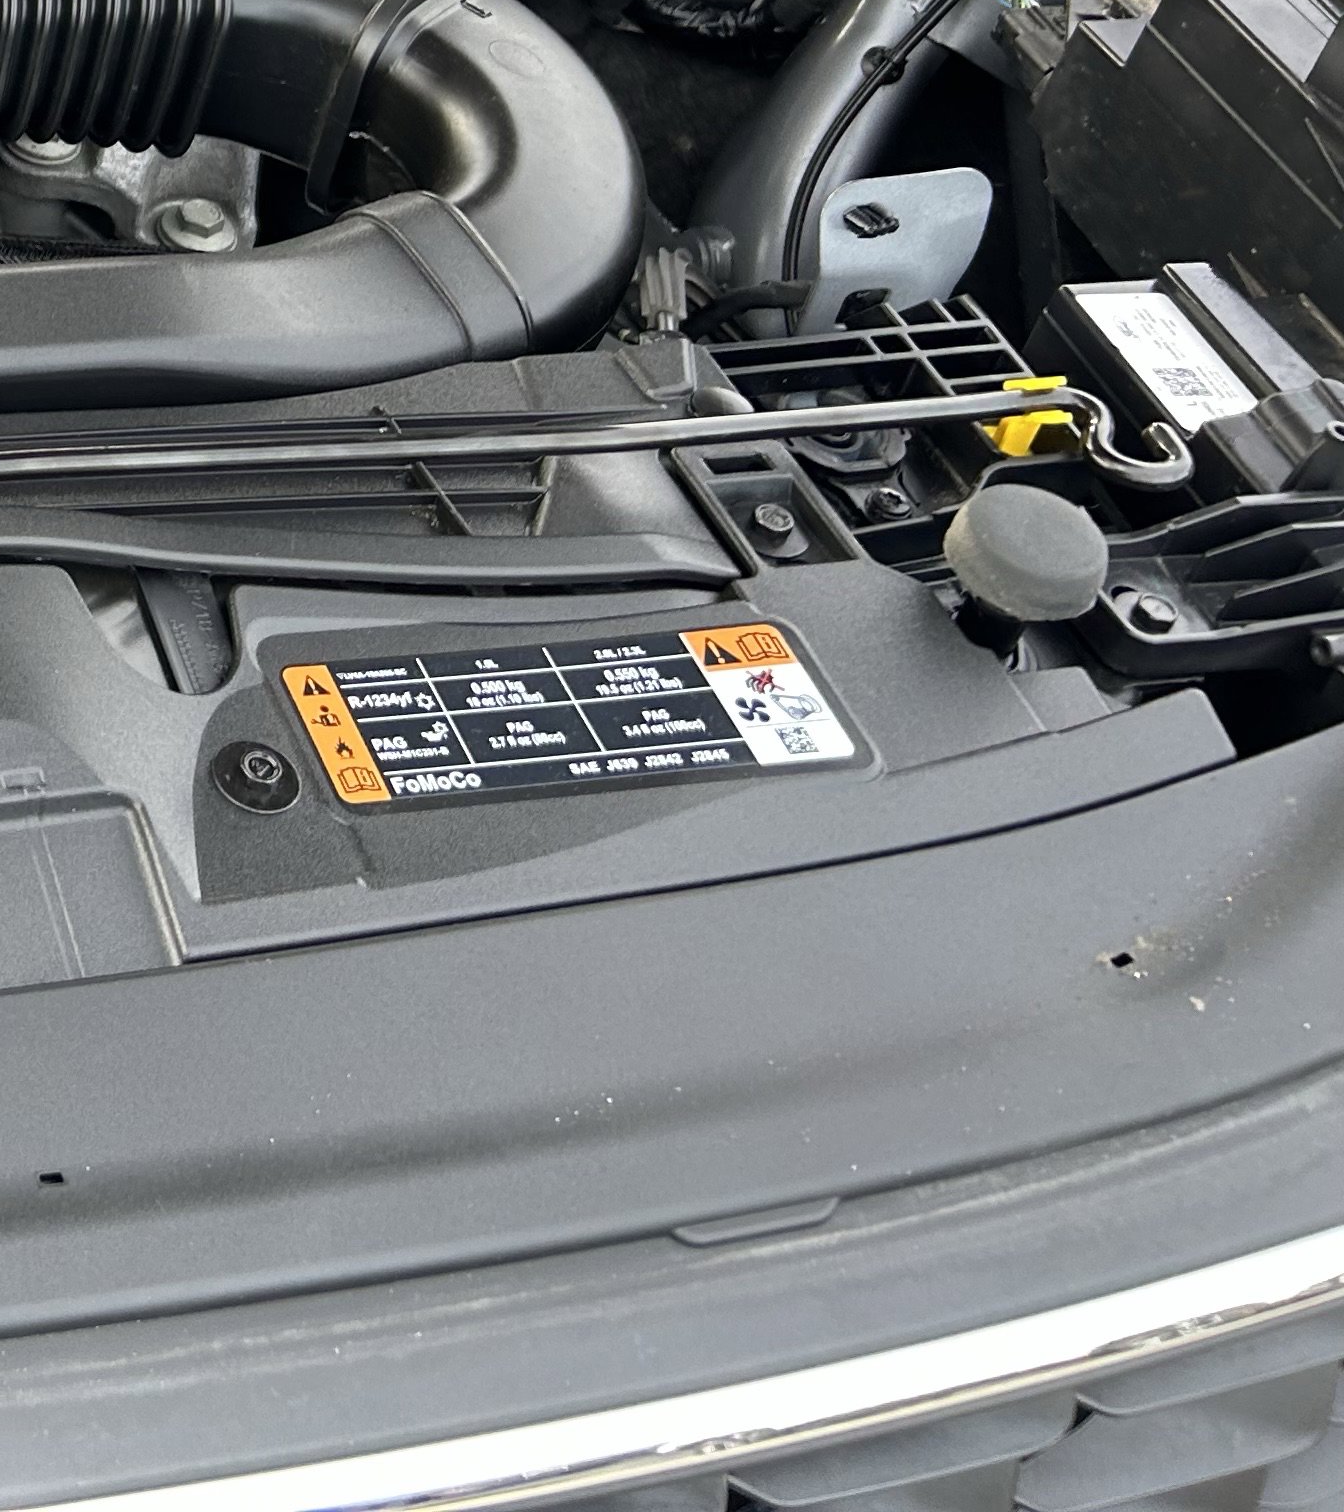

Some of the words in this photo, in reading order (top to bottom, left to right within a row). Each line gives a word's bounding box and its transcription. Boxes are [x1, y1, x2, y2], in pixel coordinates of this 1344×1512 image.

[603, 667, 639, 683] 0.550
[638, 666, 660, 680] kg
[470, 679, 506, 695] 0.500
[505, 679, 526, 693] kg
[620, 684, 634, 694] oz
[347, 691, 413, 710] R-1234yf
[481, 696, 497, 706] oz
[641, 708, 670, 722] PAG
[505, 720, 534, 734] PAG
[371, 735, 408, 752] PAG
[568, 760, 601, 776] SAE
[389, 771, 482, 795] FoMoCo
